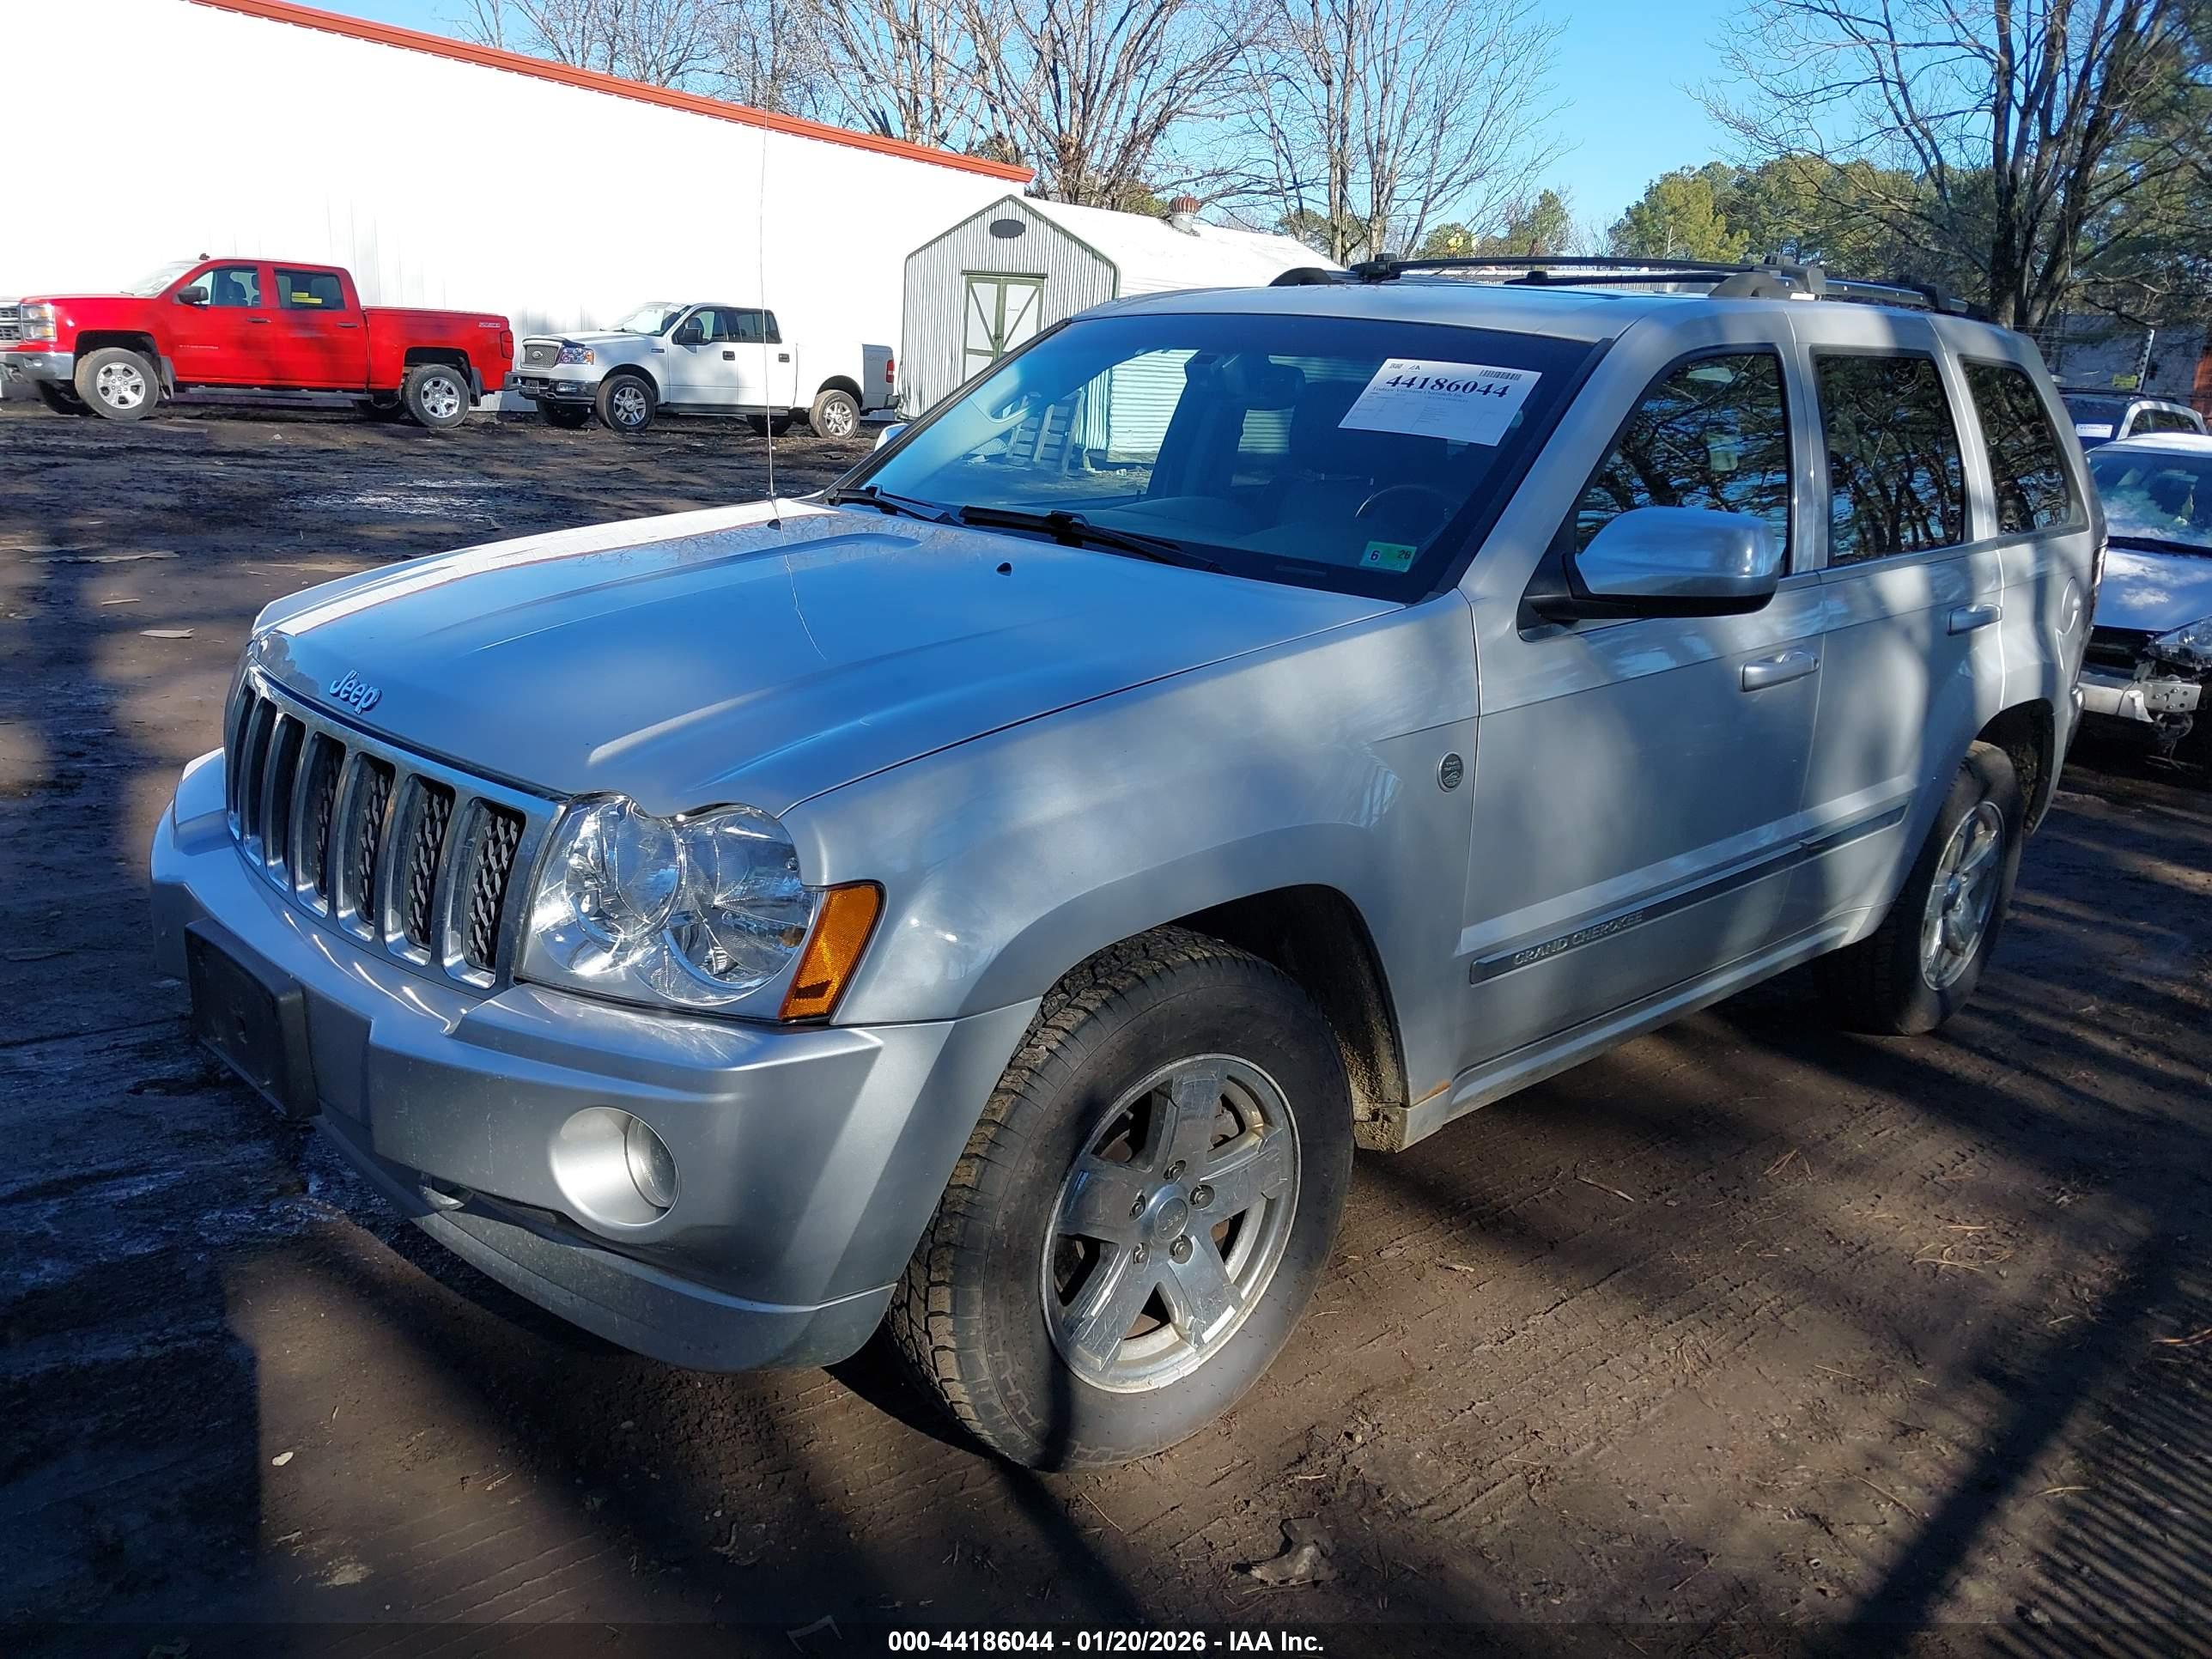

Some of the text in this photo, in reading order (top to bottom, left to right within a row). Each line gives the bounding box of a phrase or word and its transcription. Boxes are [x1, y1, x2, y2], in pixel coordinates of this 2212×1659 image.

[1385, 374, 1510, 398] 44186044
[1370, 550, 1380, 561] 6
[329, 669, 381, 714] Jeep
[1514, 912, 1644, 965] GRAND CHEROKEE
